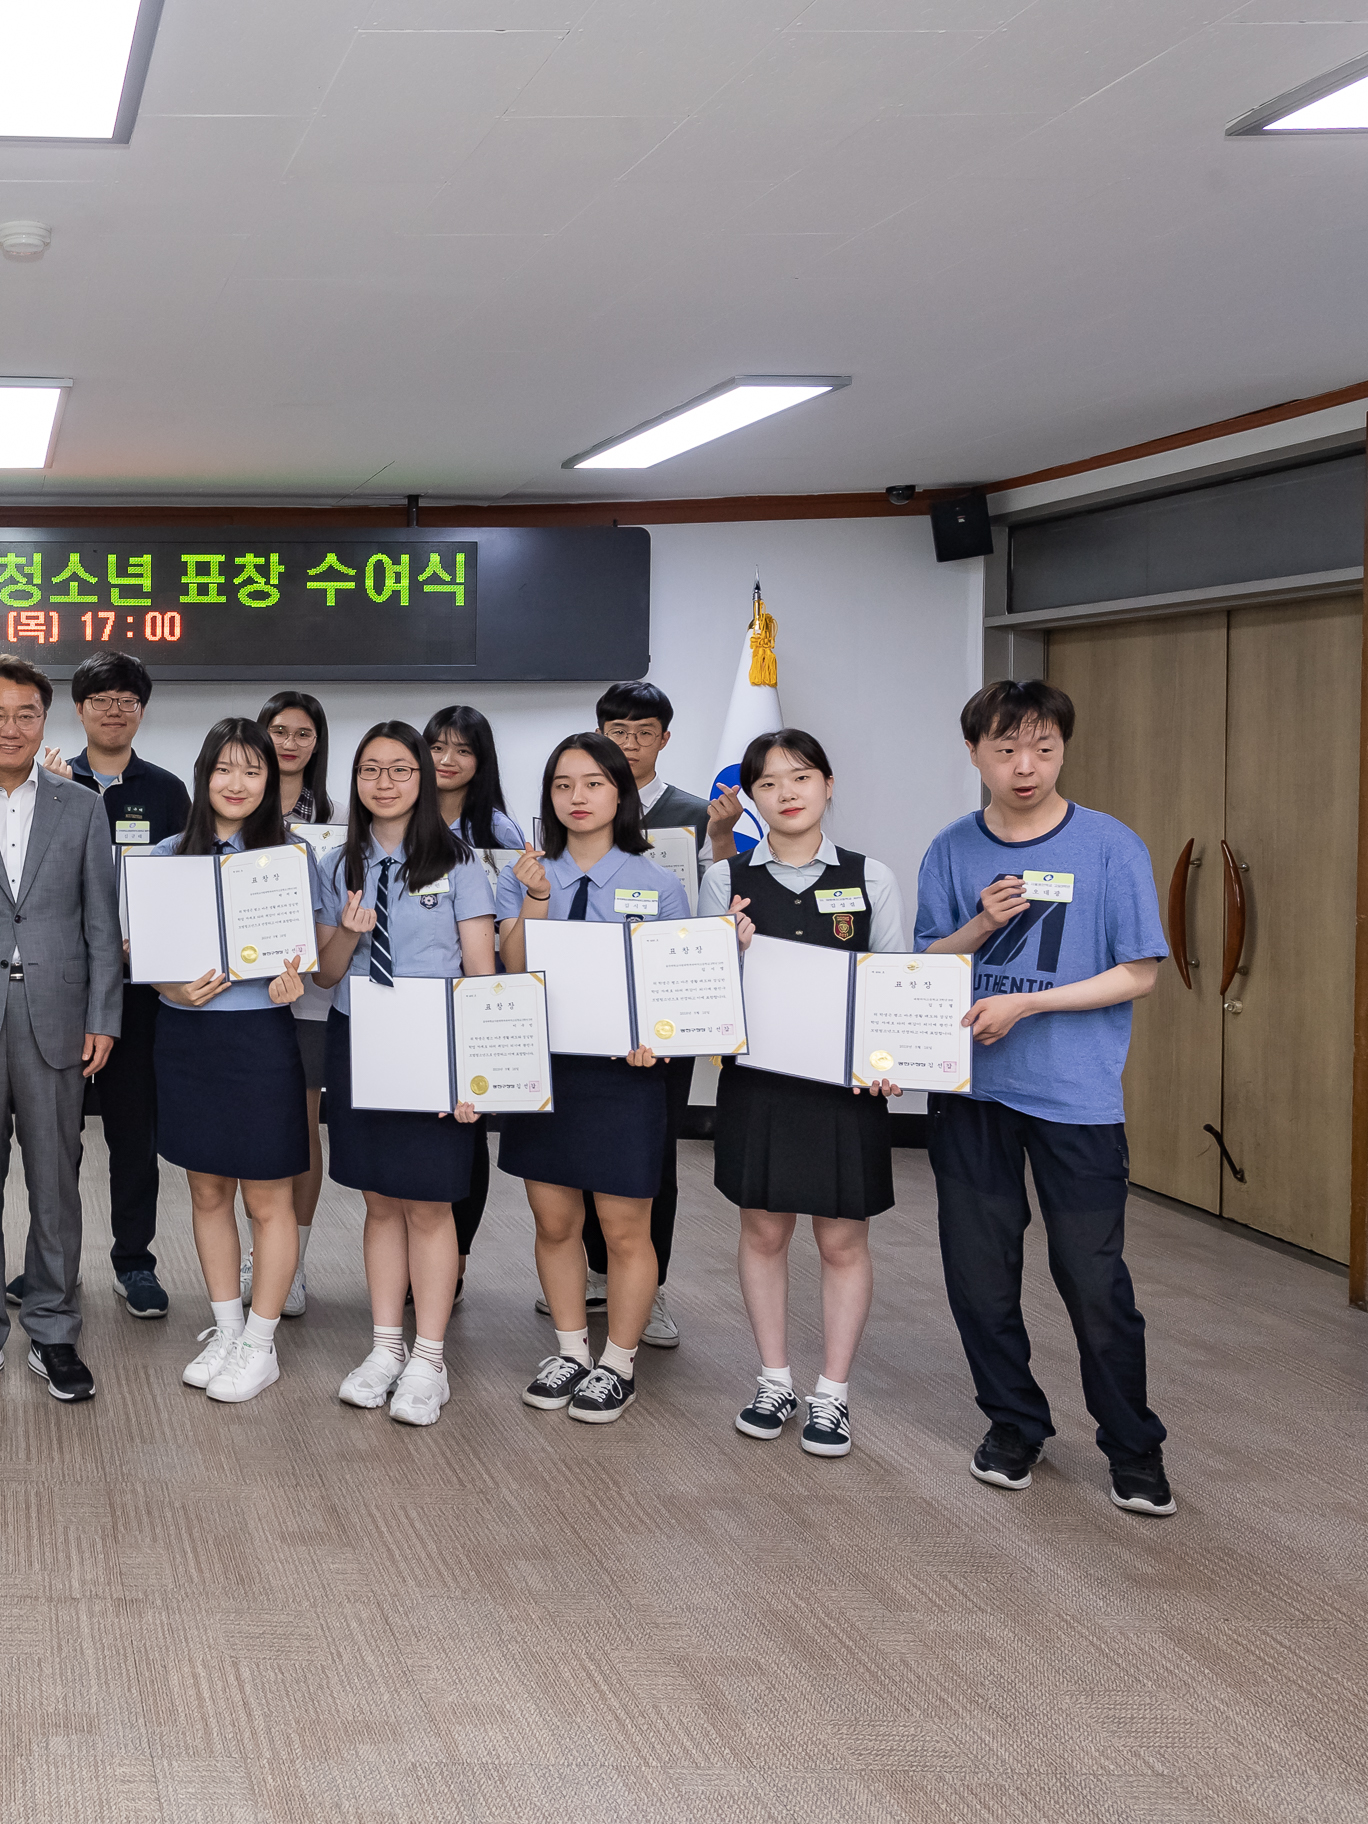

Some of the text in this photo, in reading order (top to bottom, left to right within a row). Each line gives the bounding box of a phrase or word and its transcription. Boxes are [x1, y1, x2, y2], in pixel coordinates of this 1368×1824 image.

[180, 552, 285, 608] 표창
[306, 552, 465, 607] 수여식
[974, 973, 1054, 994] UTHENTIC
